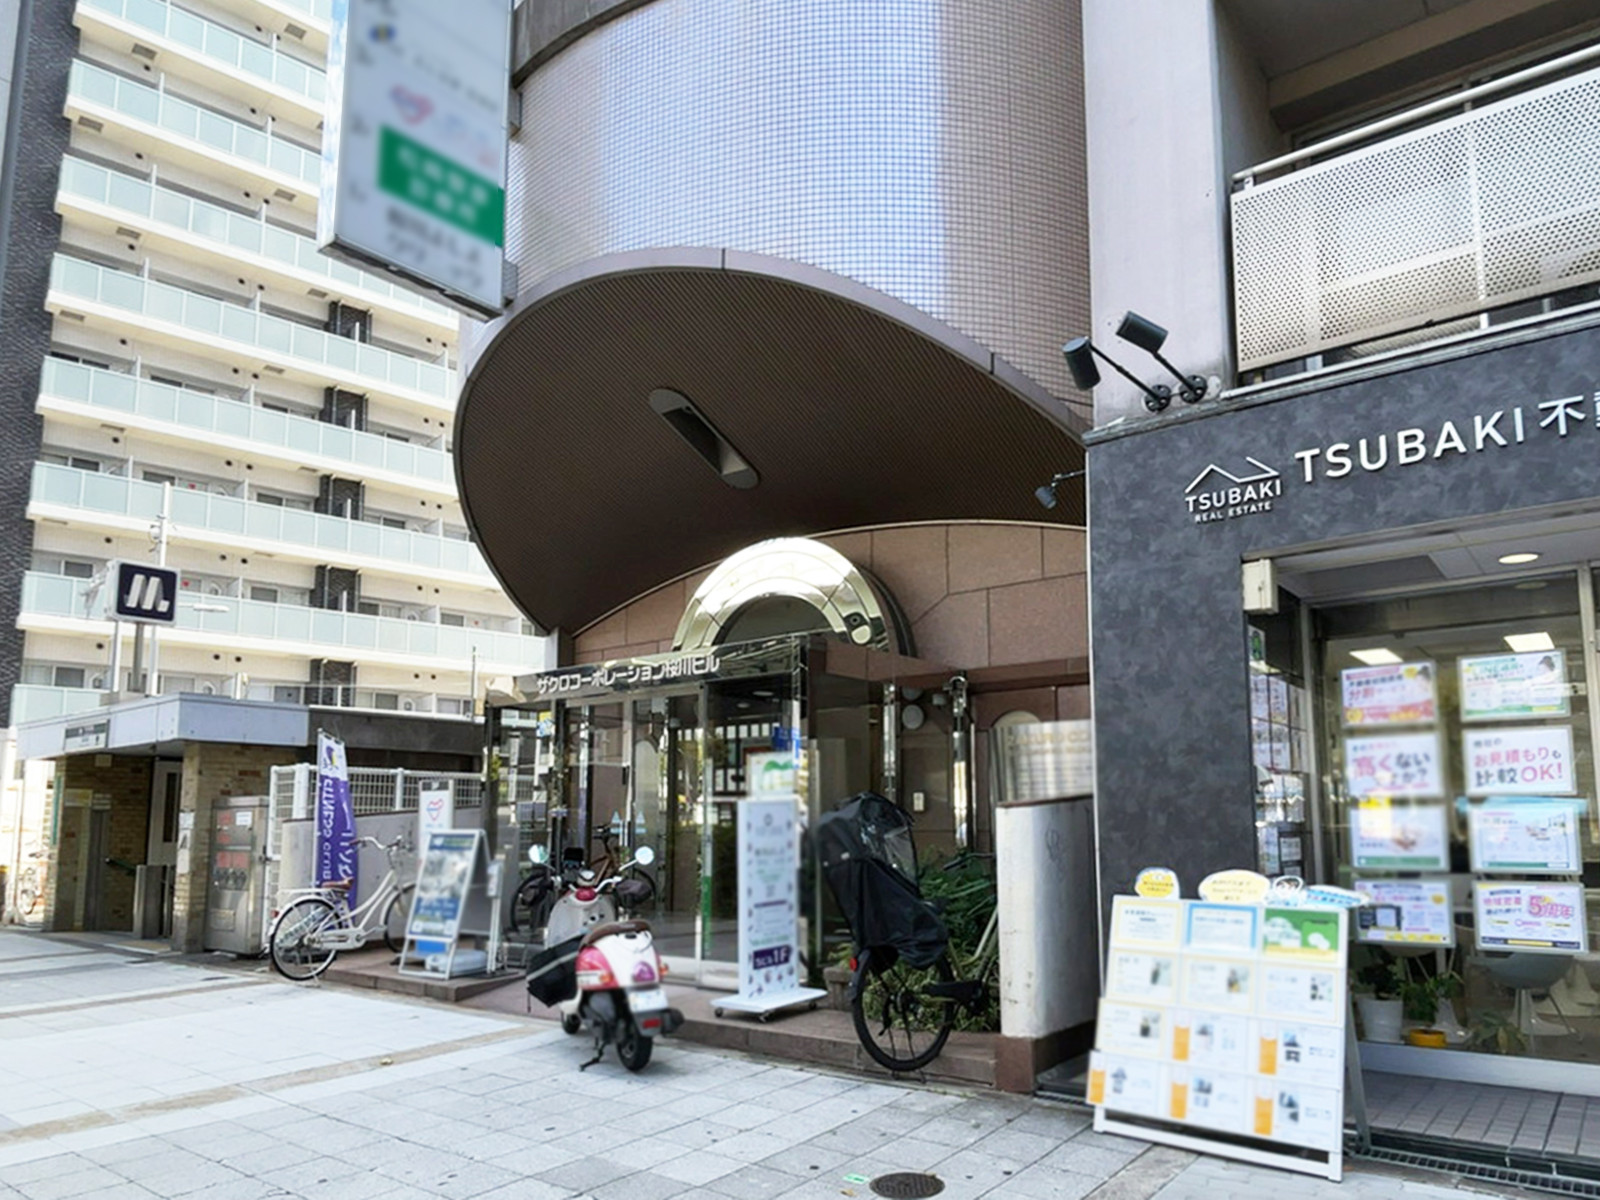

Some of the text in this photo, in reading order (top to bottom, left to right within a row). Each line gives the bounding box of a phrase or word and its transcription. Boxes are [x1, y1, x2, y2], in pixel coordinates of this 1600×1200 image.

[1294, 391, 1600, 483] TSUBAKI 不
[1185, 479, 1281, 512] TSUBAKI
[1194, 501, 1272, 523] REAL ESTATE
